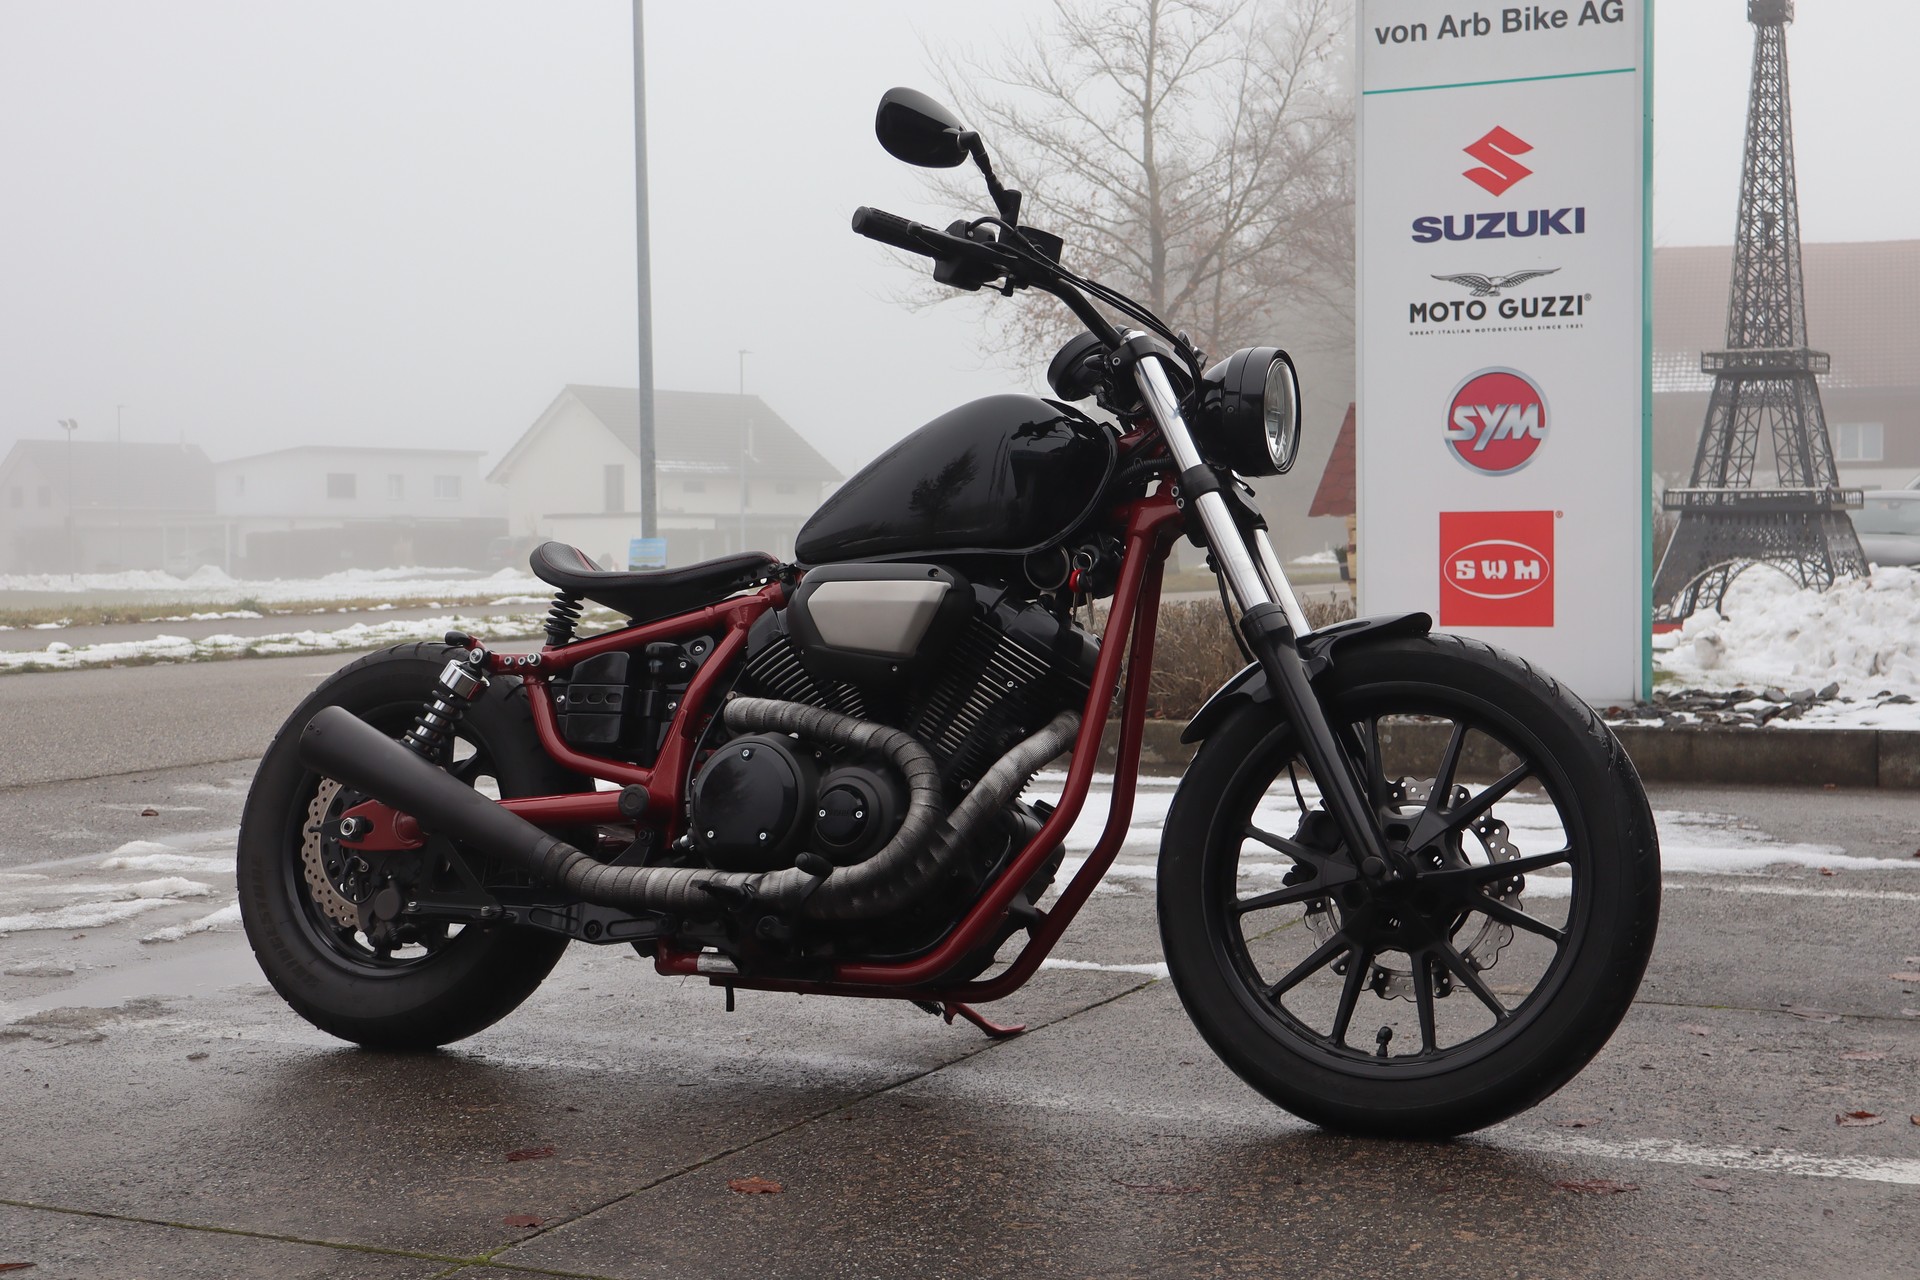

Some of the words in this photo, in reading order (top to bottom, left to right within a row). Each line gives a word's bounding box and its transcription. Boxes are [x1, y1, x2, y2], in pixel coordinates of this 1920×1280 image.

[1375, 22, 1427, 44] von
[1437, 12, 1490, 39] Arb
[1502, 6, 1568, 33] Bike
[1577, 0, 1624, 26] AG
[1411, 206, 1585, 243] SUZUKI
[1409, 300, 1487, 323] MOTO
[1498, 295, 1583, 320] GUZZI
[1475, 326, 1534, 334] MOTORCYCLES
[1444, 403, 1545, 451] SYM
[1455, 560, 1540, 580] SWM
